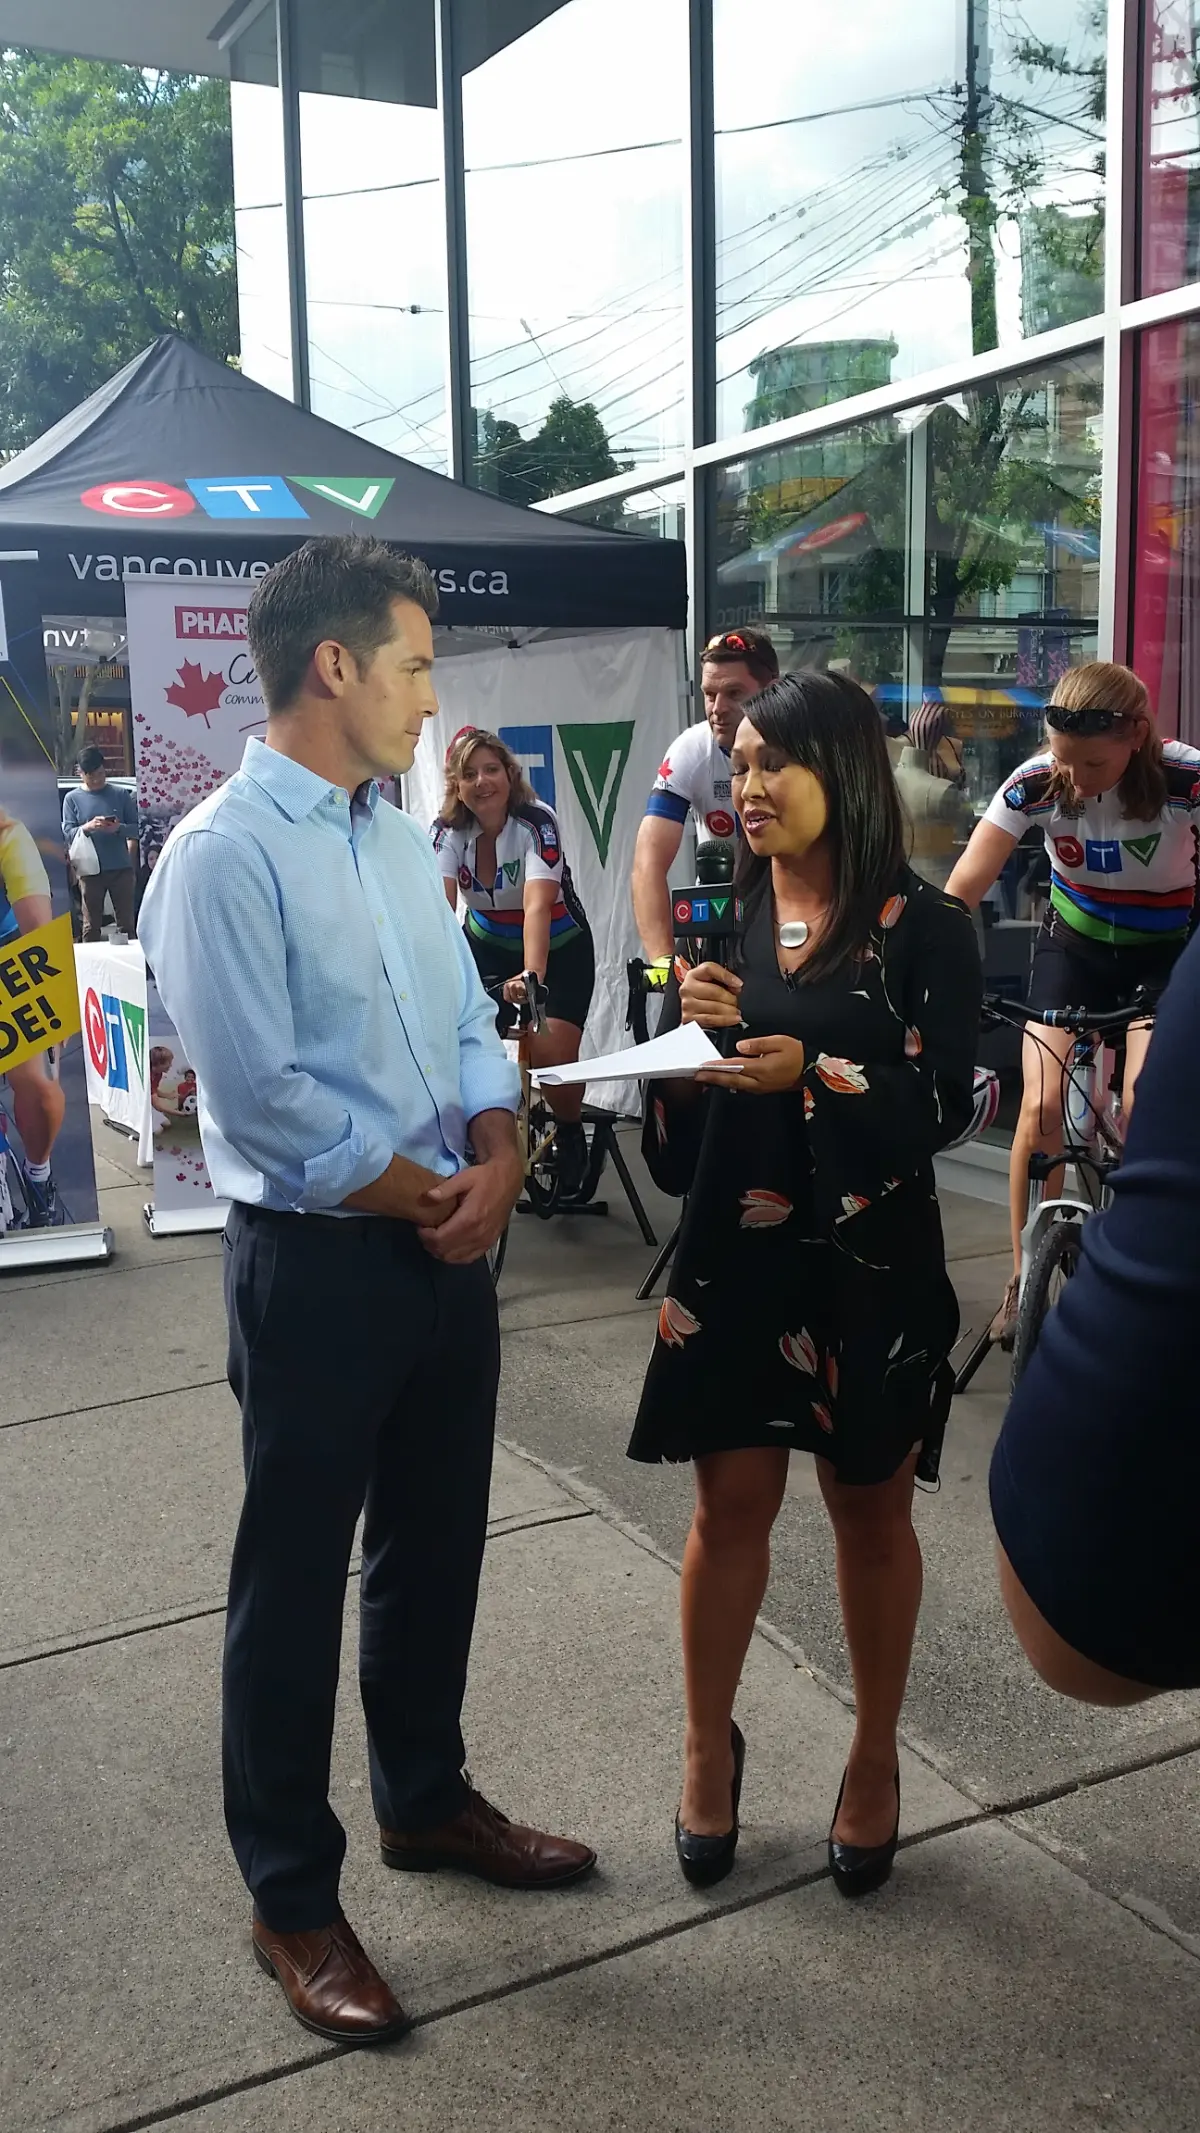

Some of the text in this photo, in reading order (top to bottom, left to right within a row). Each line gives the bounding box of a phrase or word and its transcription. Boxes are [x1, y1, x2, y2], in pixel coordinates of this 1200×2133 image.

[97, 481, 386, 515] CTV
[181, 611, 248, 635] PHAR
[224, 694, 265, 705] comm
[1056, 839, 1158, 870] CTV
[675, 899, 728, 921] CTV
[0, 945, 62, 998] ER
[88, 1001, 144, 1072] CTV
